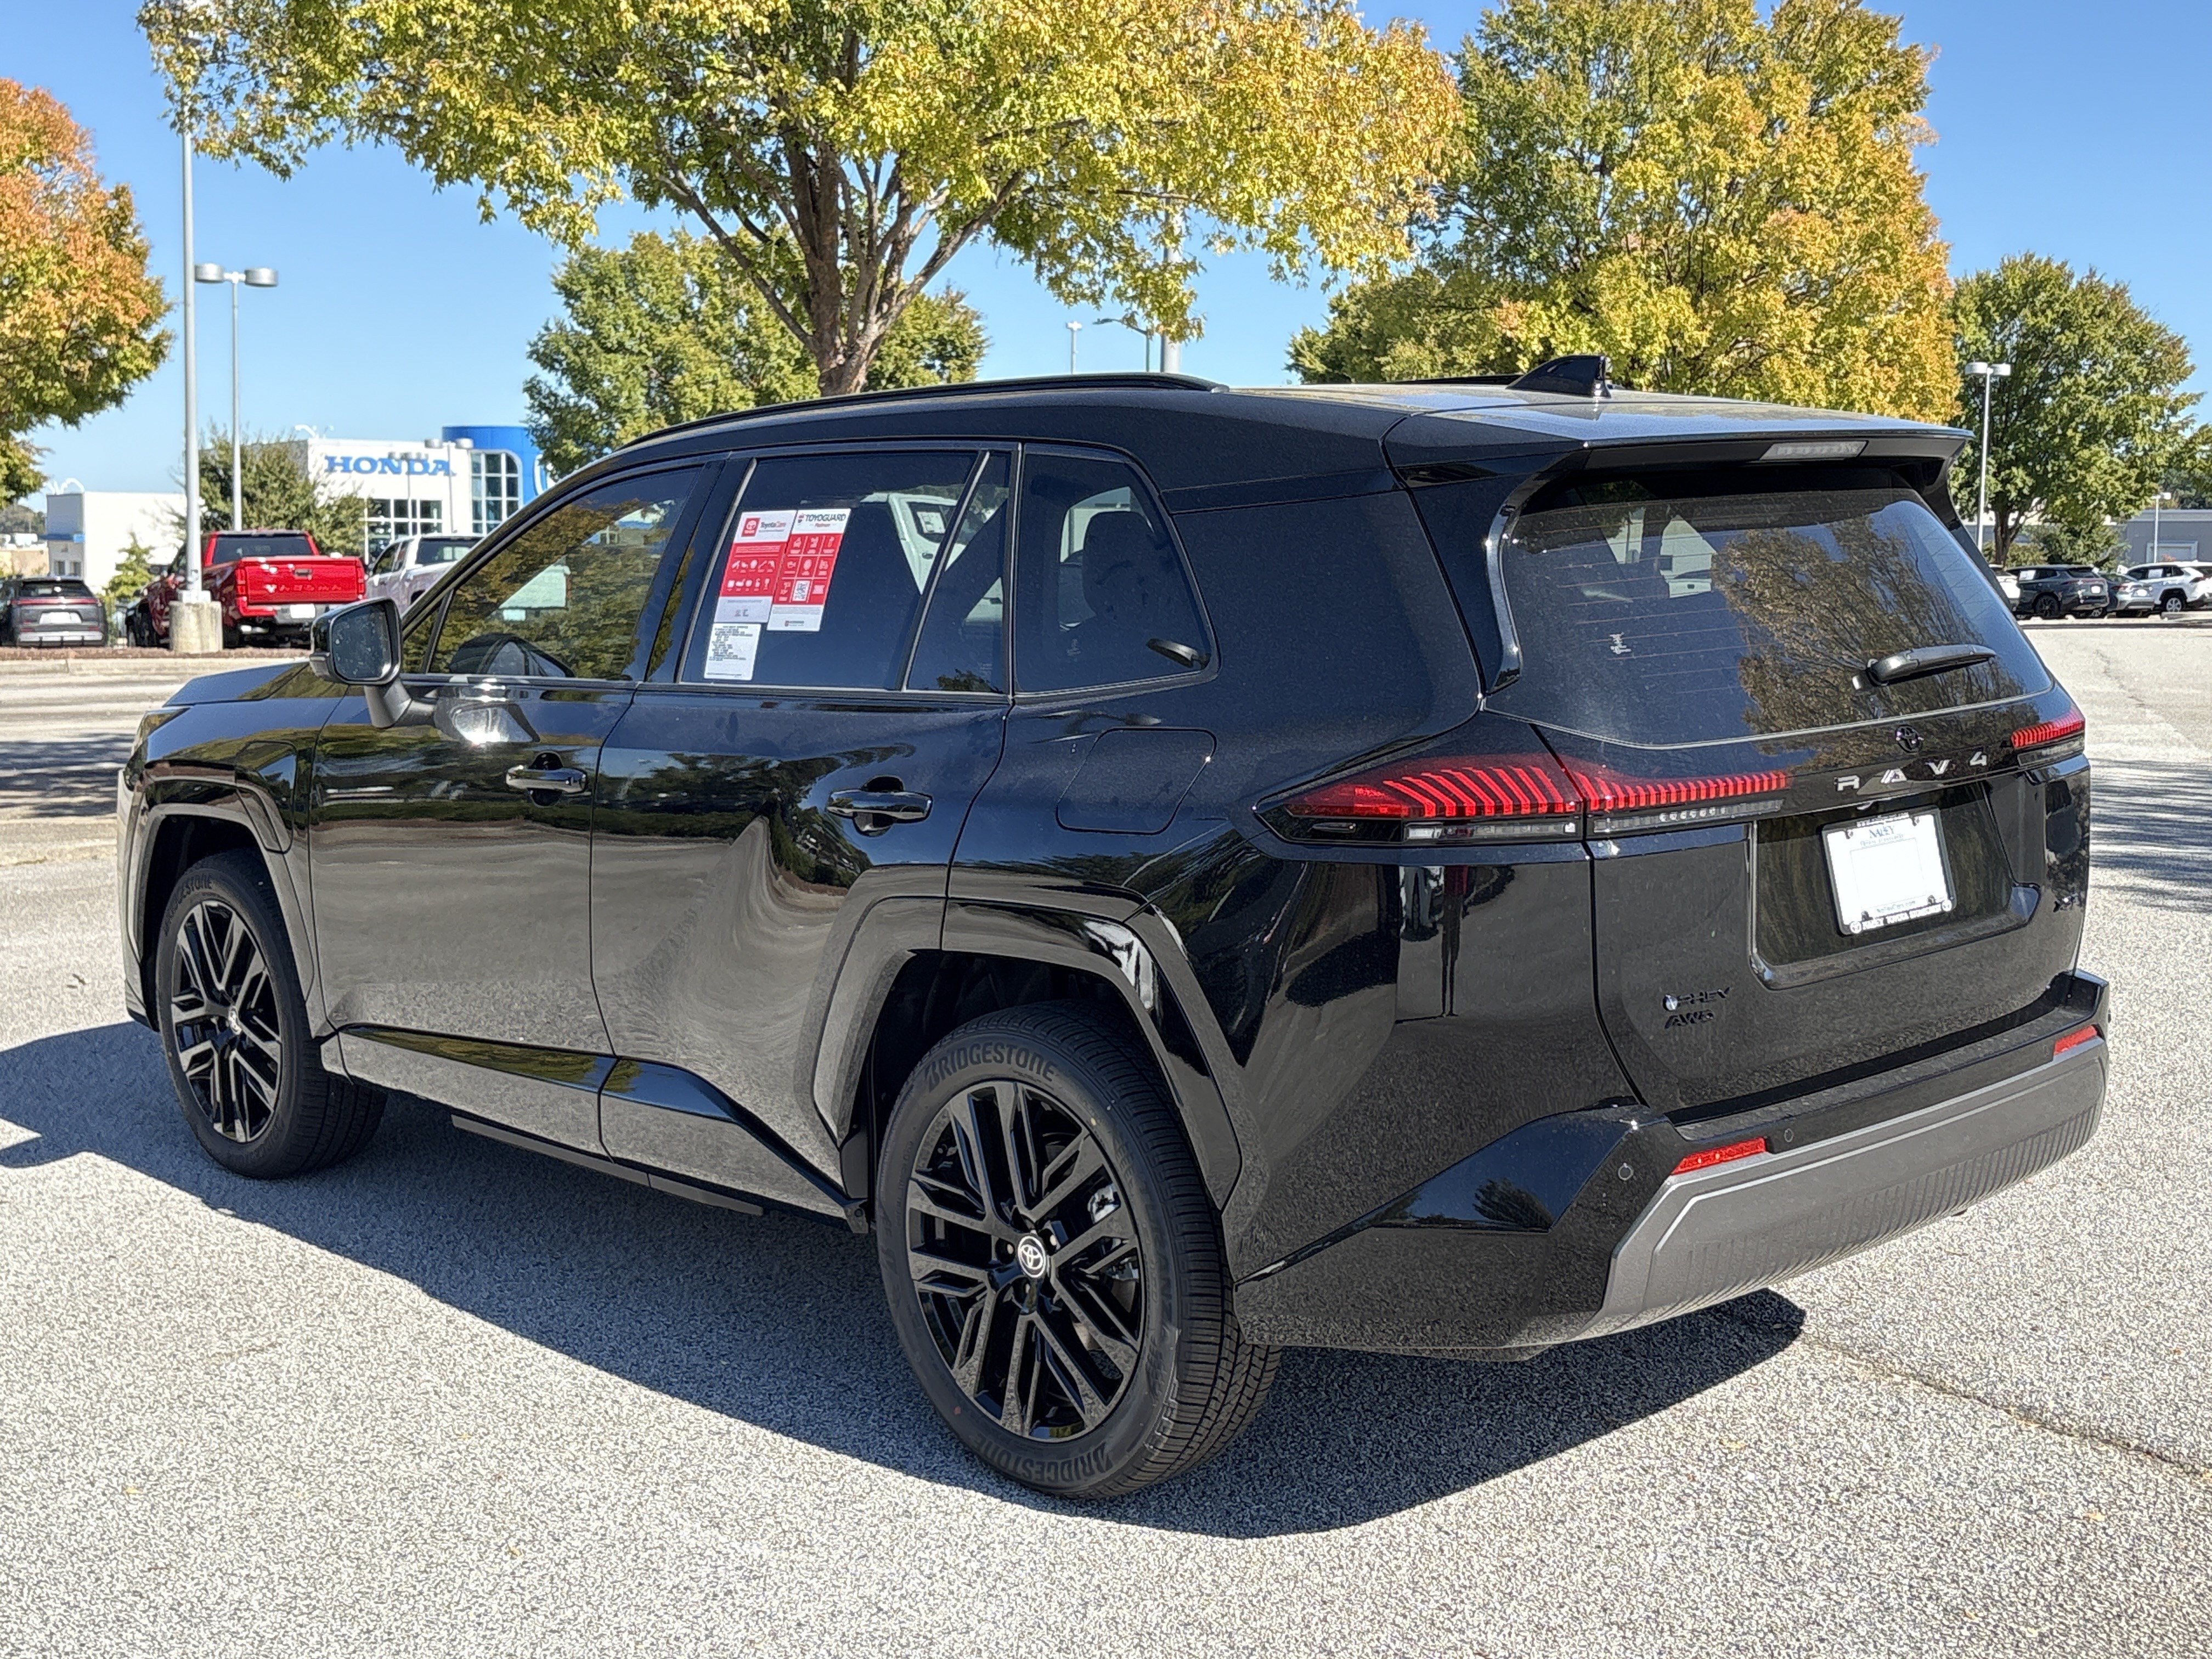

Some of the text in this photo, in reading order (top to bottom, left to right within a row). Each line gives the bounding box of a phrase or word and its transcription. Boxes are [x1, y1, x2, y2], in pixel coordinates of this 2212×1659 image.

[324, 456, 456, 476] HONDA
[805, 514, 846, 522] TOYOGUARD
[1835, 751, 1988, 792] RAV4
[925, 1042, 1058, 1093] BRIDGESTONE
[974, 1432, 1113, 1483] BRIDGESTONE
